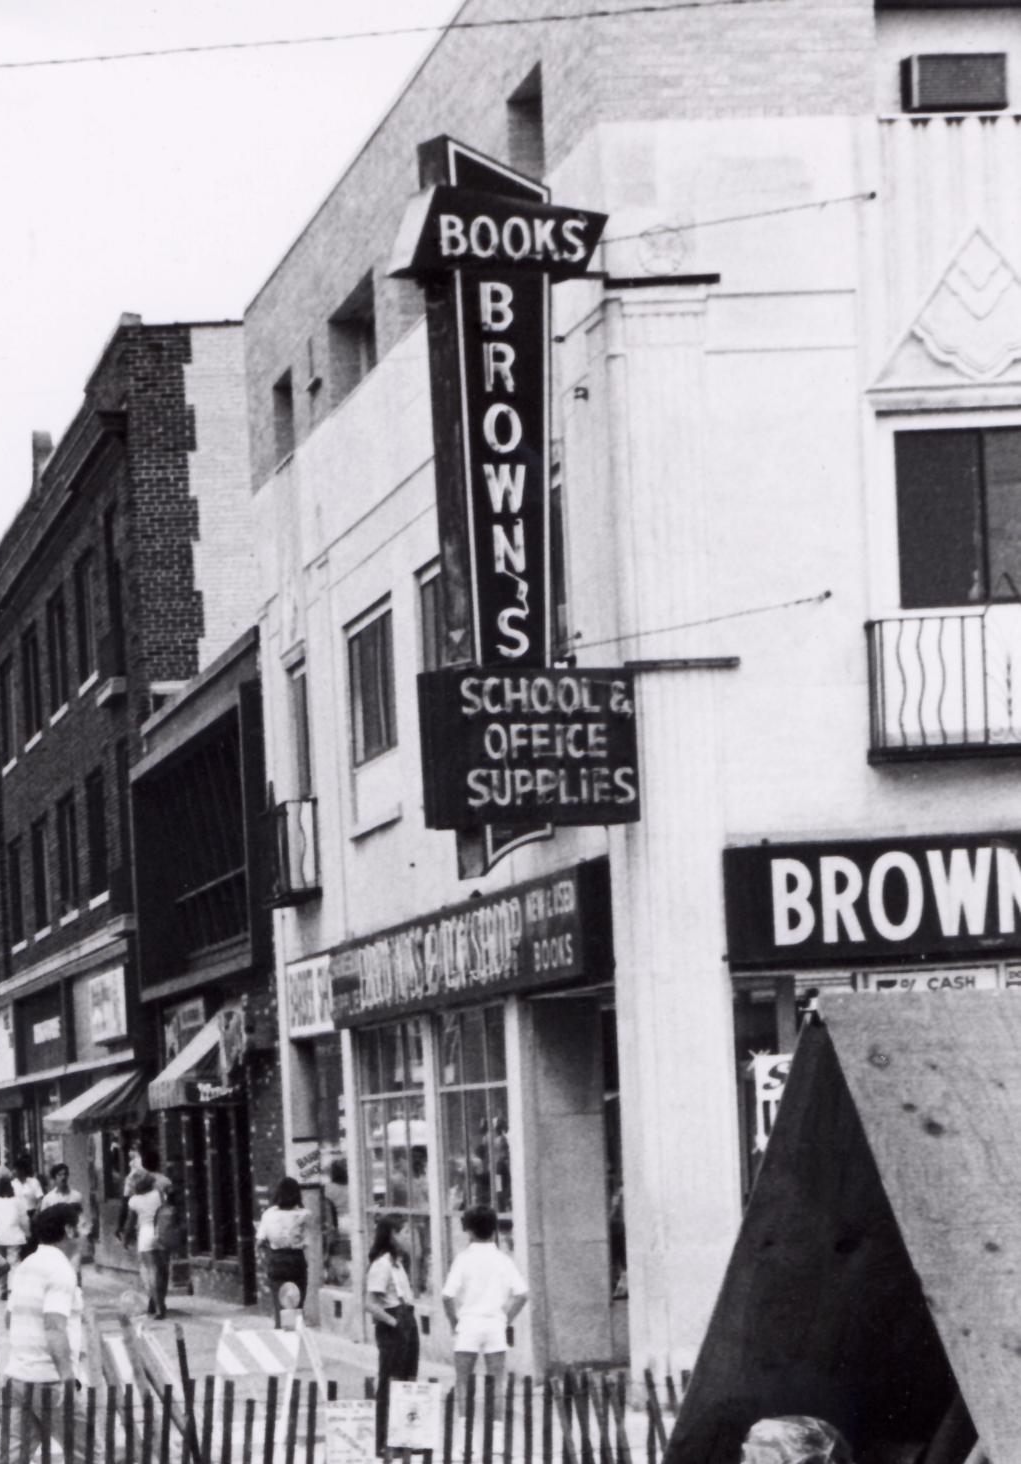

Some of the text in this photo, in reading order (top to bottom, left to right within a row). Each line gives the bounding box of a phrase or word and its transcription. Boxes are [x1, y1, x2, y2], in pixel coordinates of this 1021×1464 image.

[439, 213, 587, 262] BOOKS
[479, 281, 530, 659] BROWN'S
[460, 675, 634, 718] SCHOOL &
[483, 721, 609, 760] OFFICE
[465, 765, 637, 808] SUPPLIES
[533, 932, 574, 973] BOOKS
[926, 975, 976, 991] CASH
